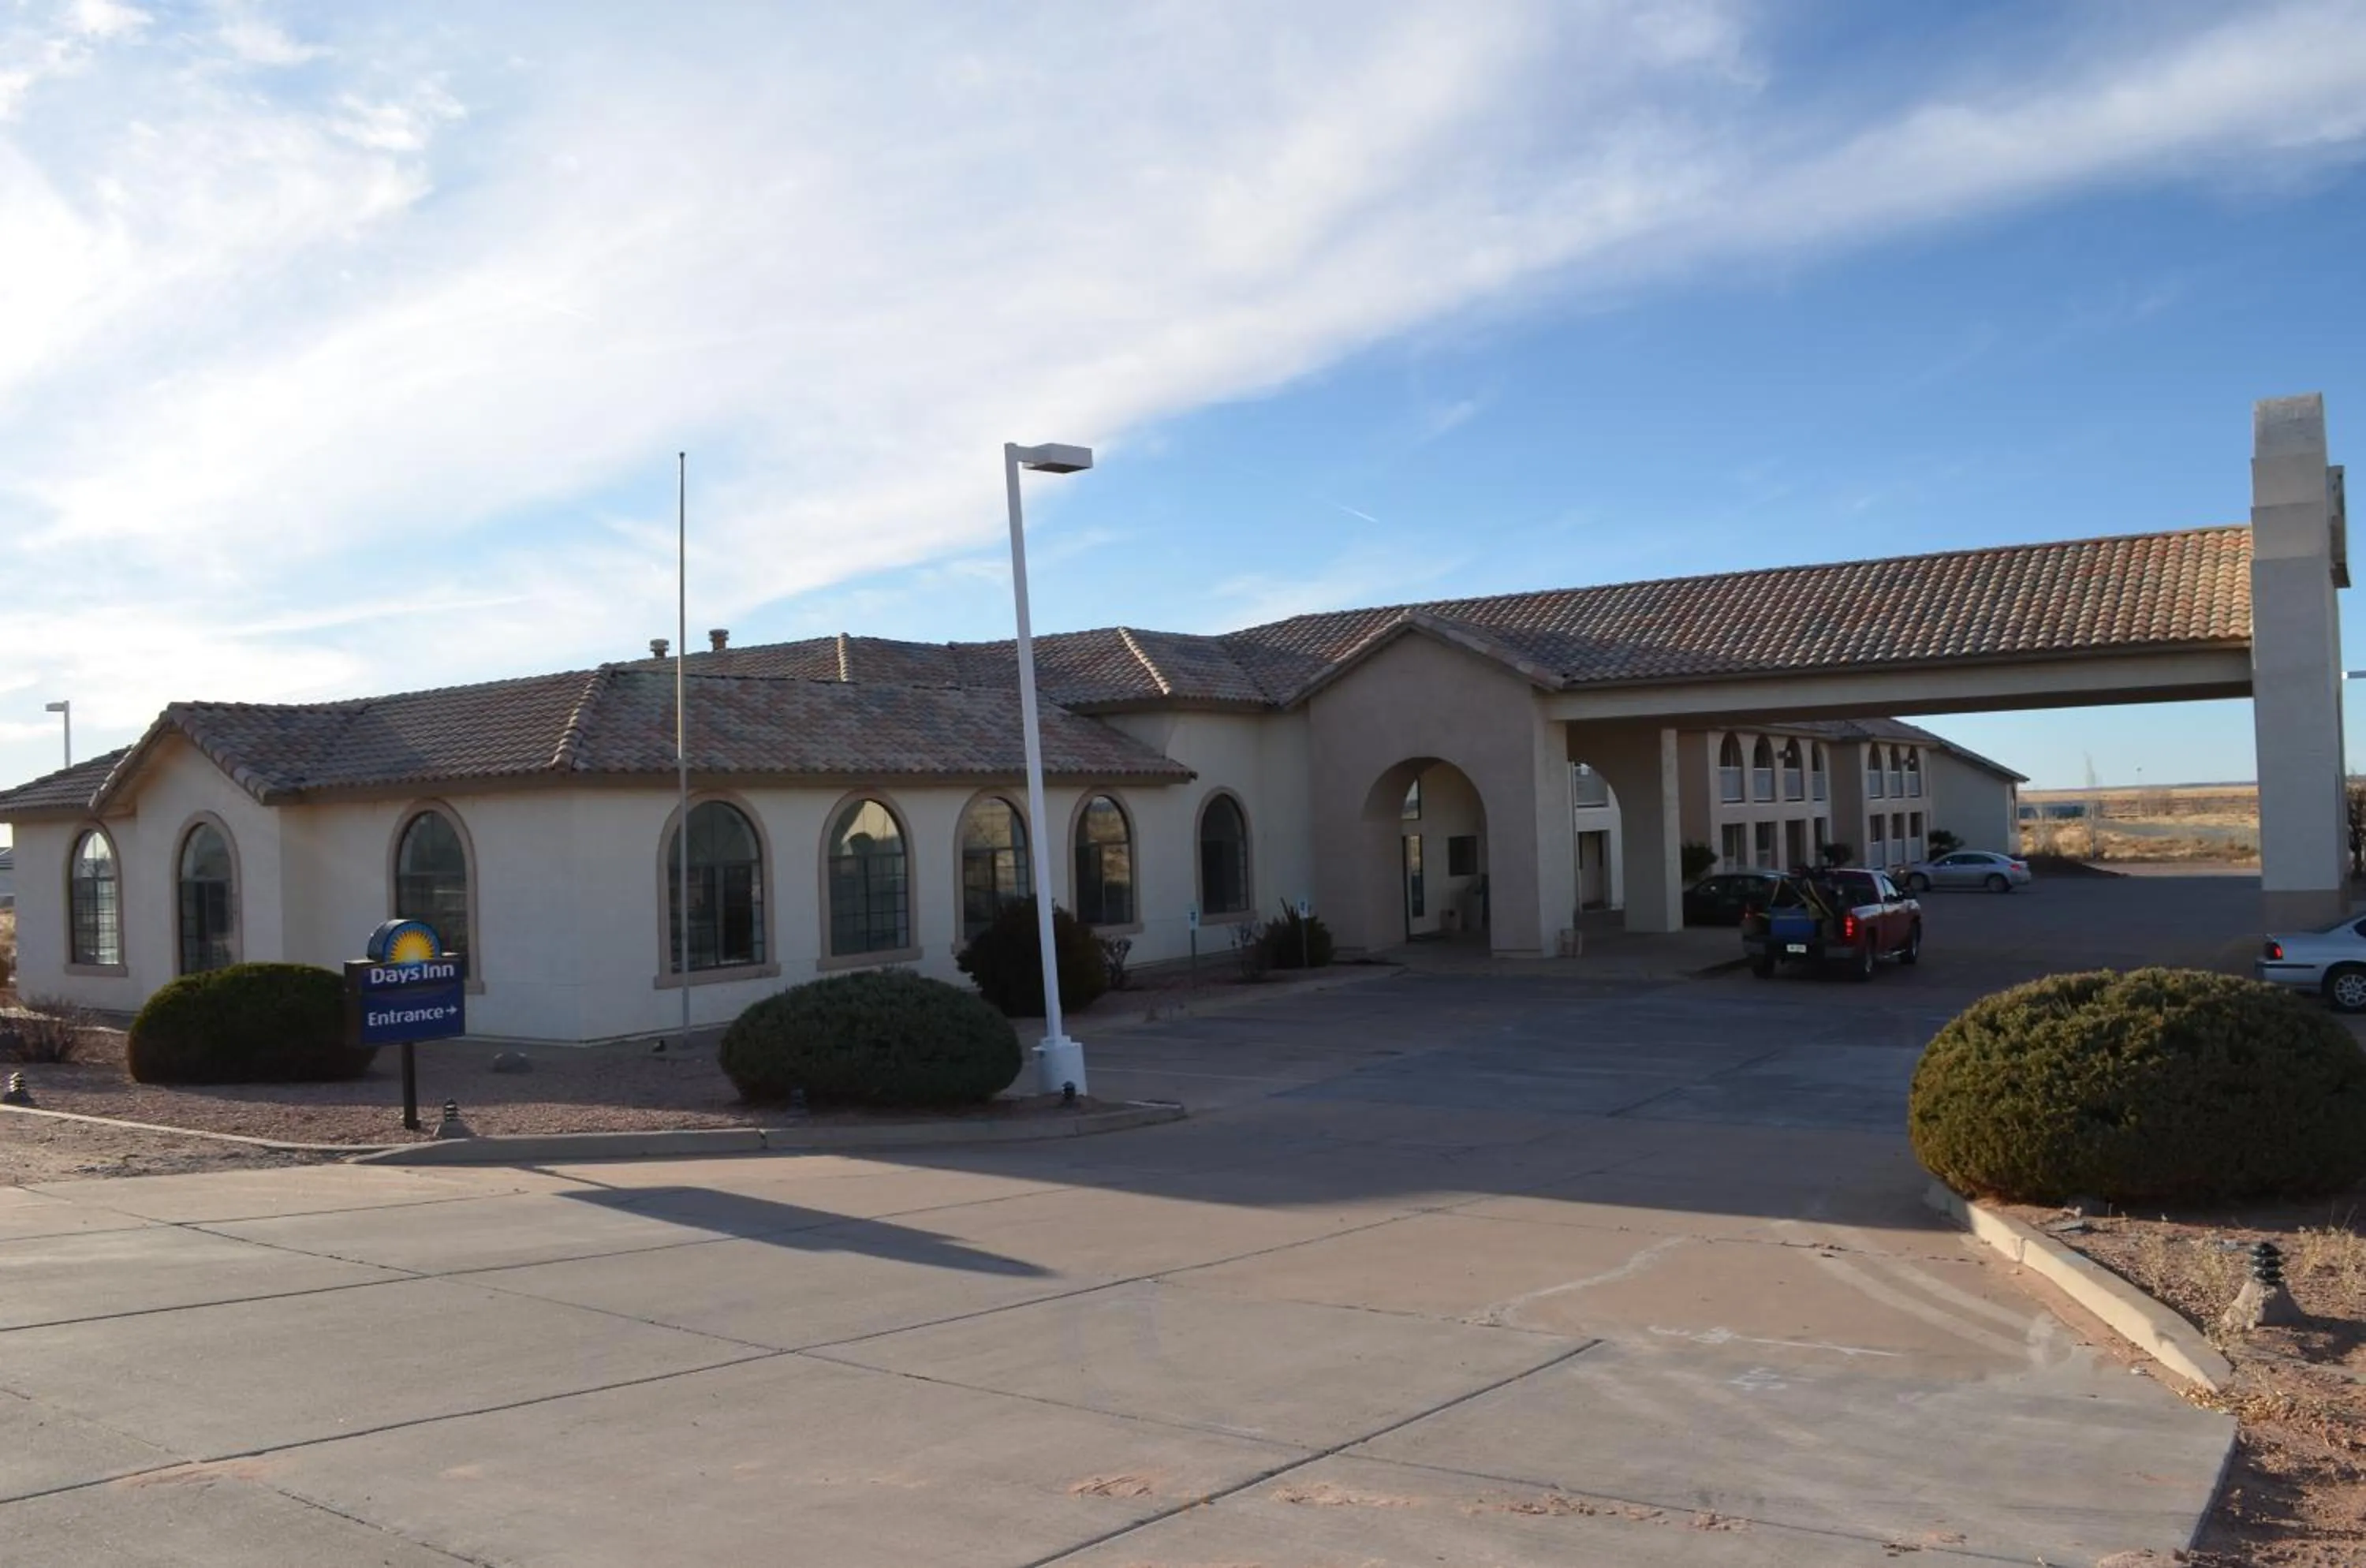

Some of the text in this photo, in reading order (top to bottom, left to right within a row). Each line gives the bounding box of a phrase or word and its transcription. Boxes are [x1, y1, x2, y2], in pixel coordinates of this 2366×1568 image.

[371, 963, 454, 984] Days Inn
[368, 1007, 443, 1026] Entrance
